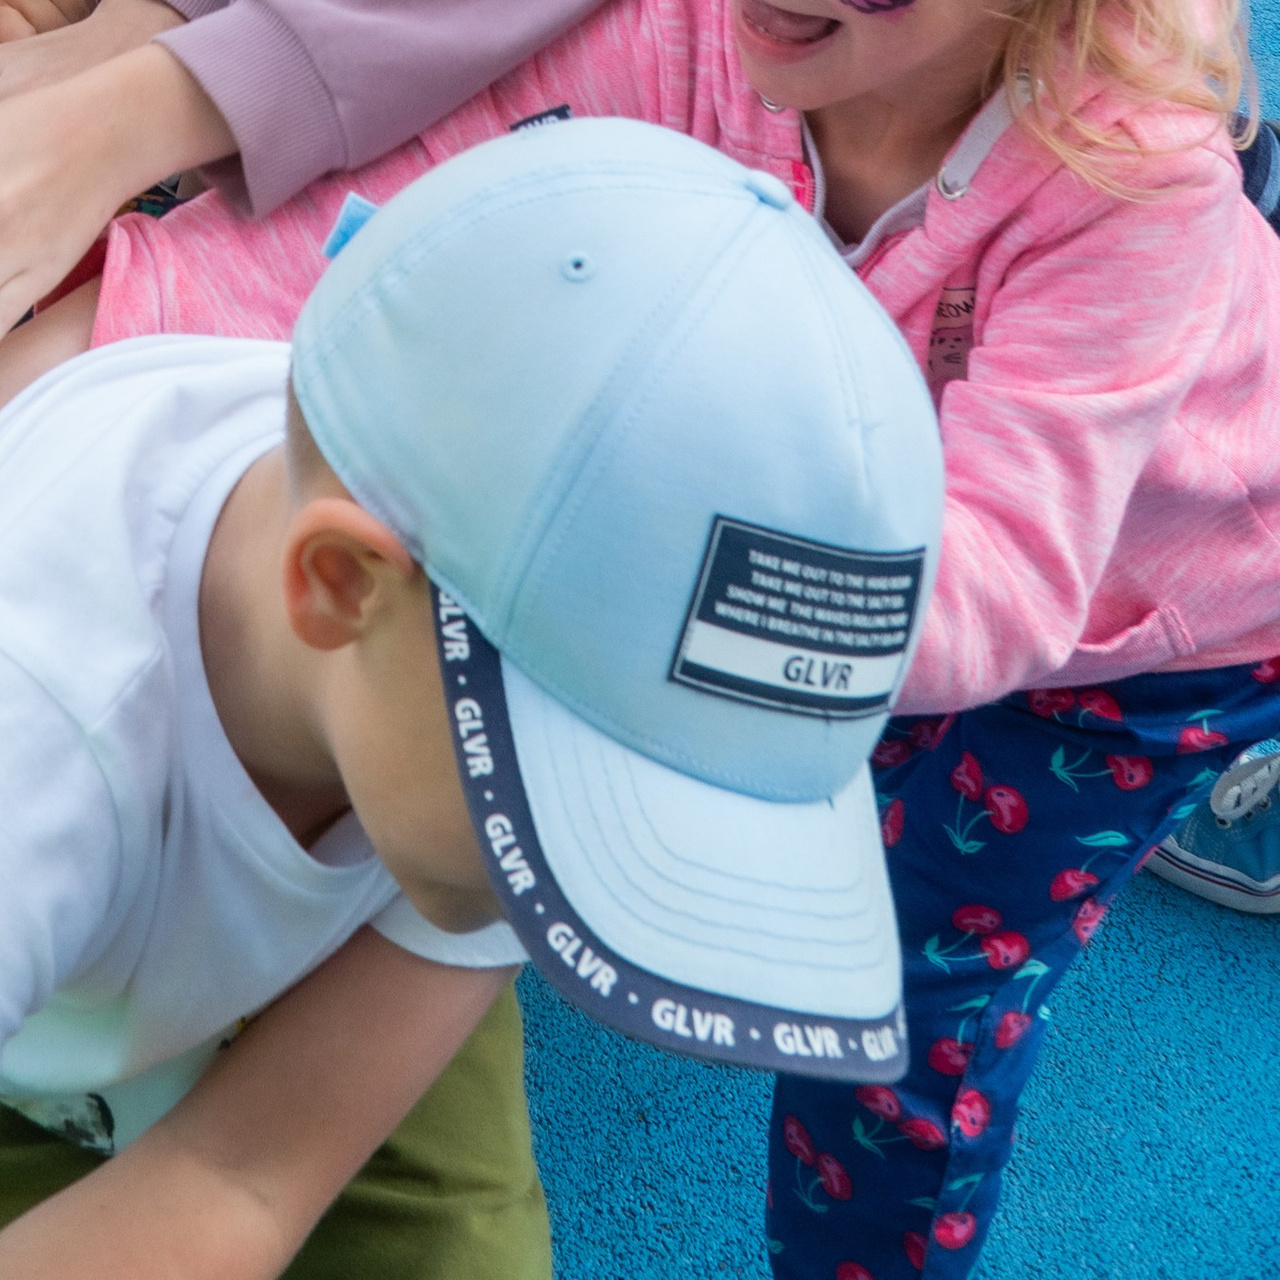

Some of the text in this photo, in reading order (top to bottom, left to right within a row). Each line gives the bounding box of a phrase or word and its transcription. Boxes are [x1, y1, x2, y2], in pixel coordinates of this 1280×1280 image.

[783, 655, 853, 690] GLVR
[455, 698, 494, 778] GLVR
[485, 813, 535, 895] GLVR
[546, 922, 618, 997] GLVR
[651, 998, 735, 1047] GLVR
[773, 1022, 844, 1060] GLVR
